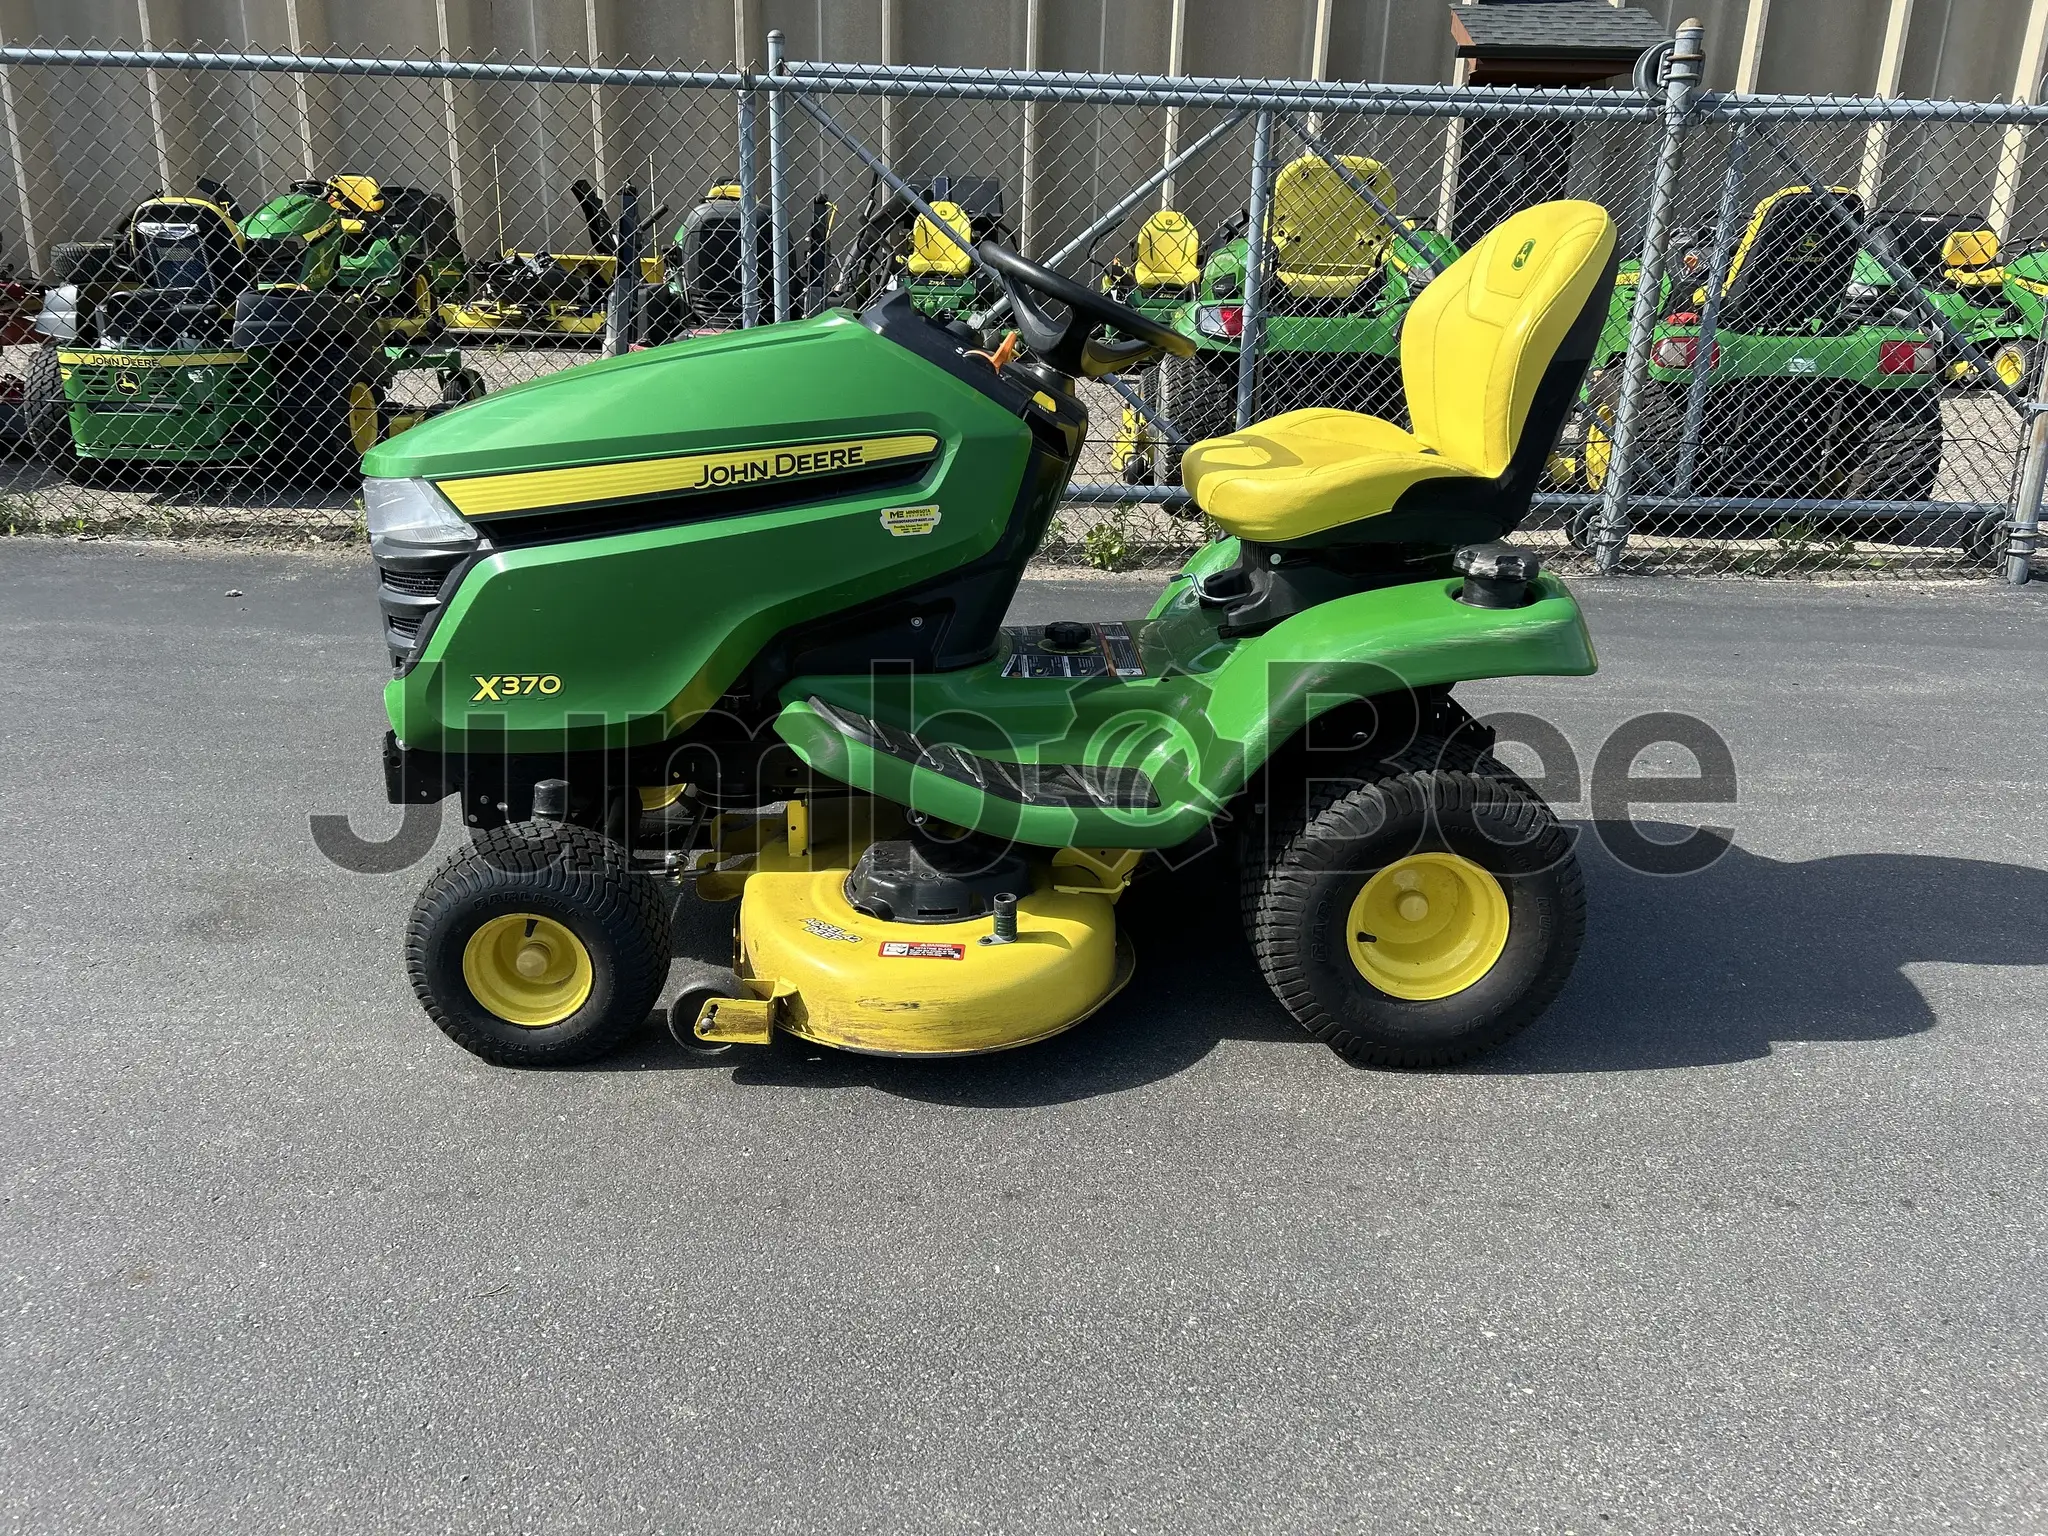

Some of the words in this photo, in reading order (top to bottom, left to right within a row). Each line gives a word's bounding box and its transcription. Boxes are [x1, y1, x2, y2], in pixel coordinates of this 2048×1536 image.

[90, 355, 120, 367] JOHN
[121, 356, 161, 367] DEERE
[694, 460, 769, 488] JOHN
[774, 446, 864, 476] DEERE
[471, 675, 562, 701] X370
